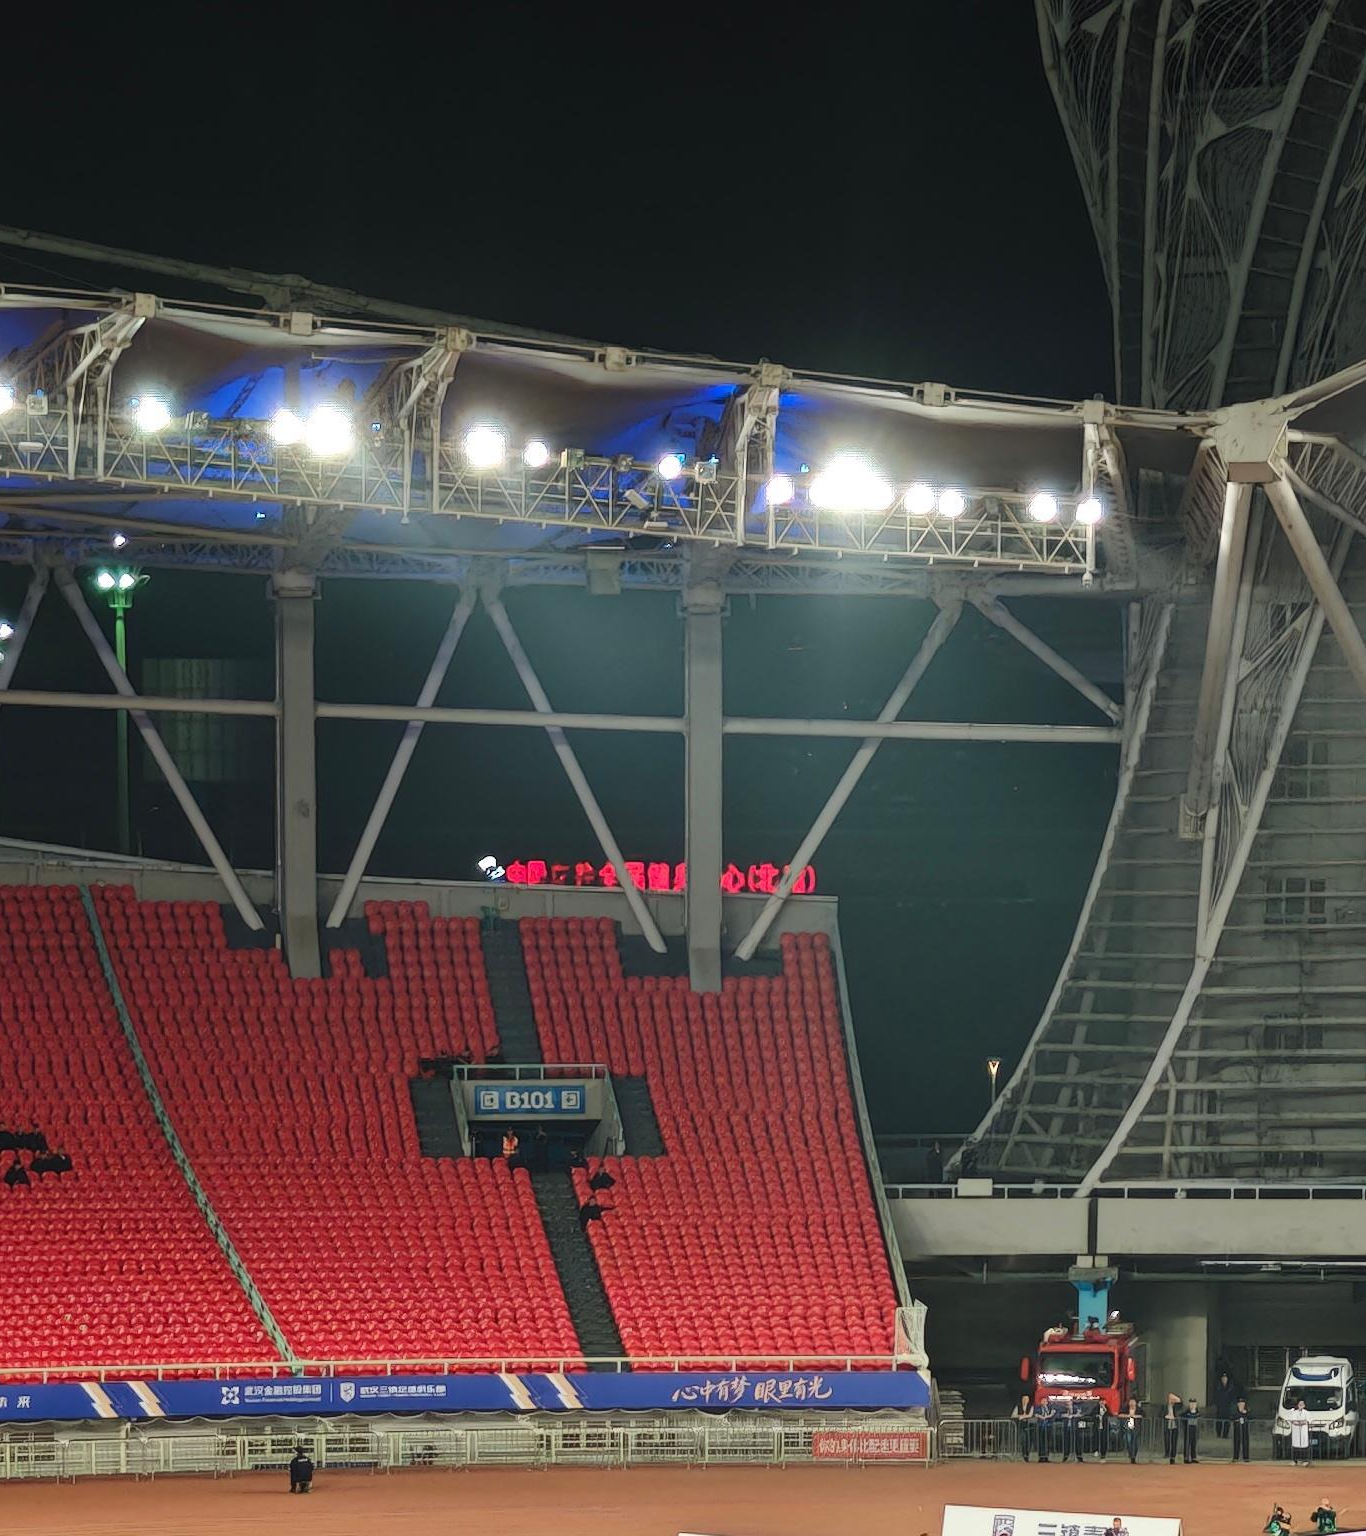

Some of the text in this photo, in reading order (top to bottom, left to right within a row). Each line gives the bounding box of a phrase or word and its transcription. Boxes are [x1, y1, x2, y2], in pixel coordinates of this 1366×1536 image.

[505, 1091, 555, 1109] B101
[672, 1375, 833, 1403] 心中有梦 眼里有光
